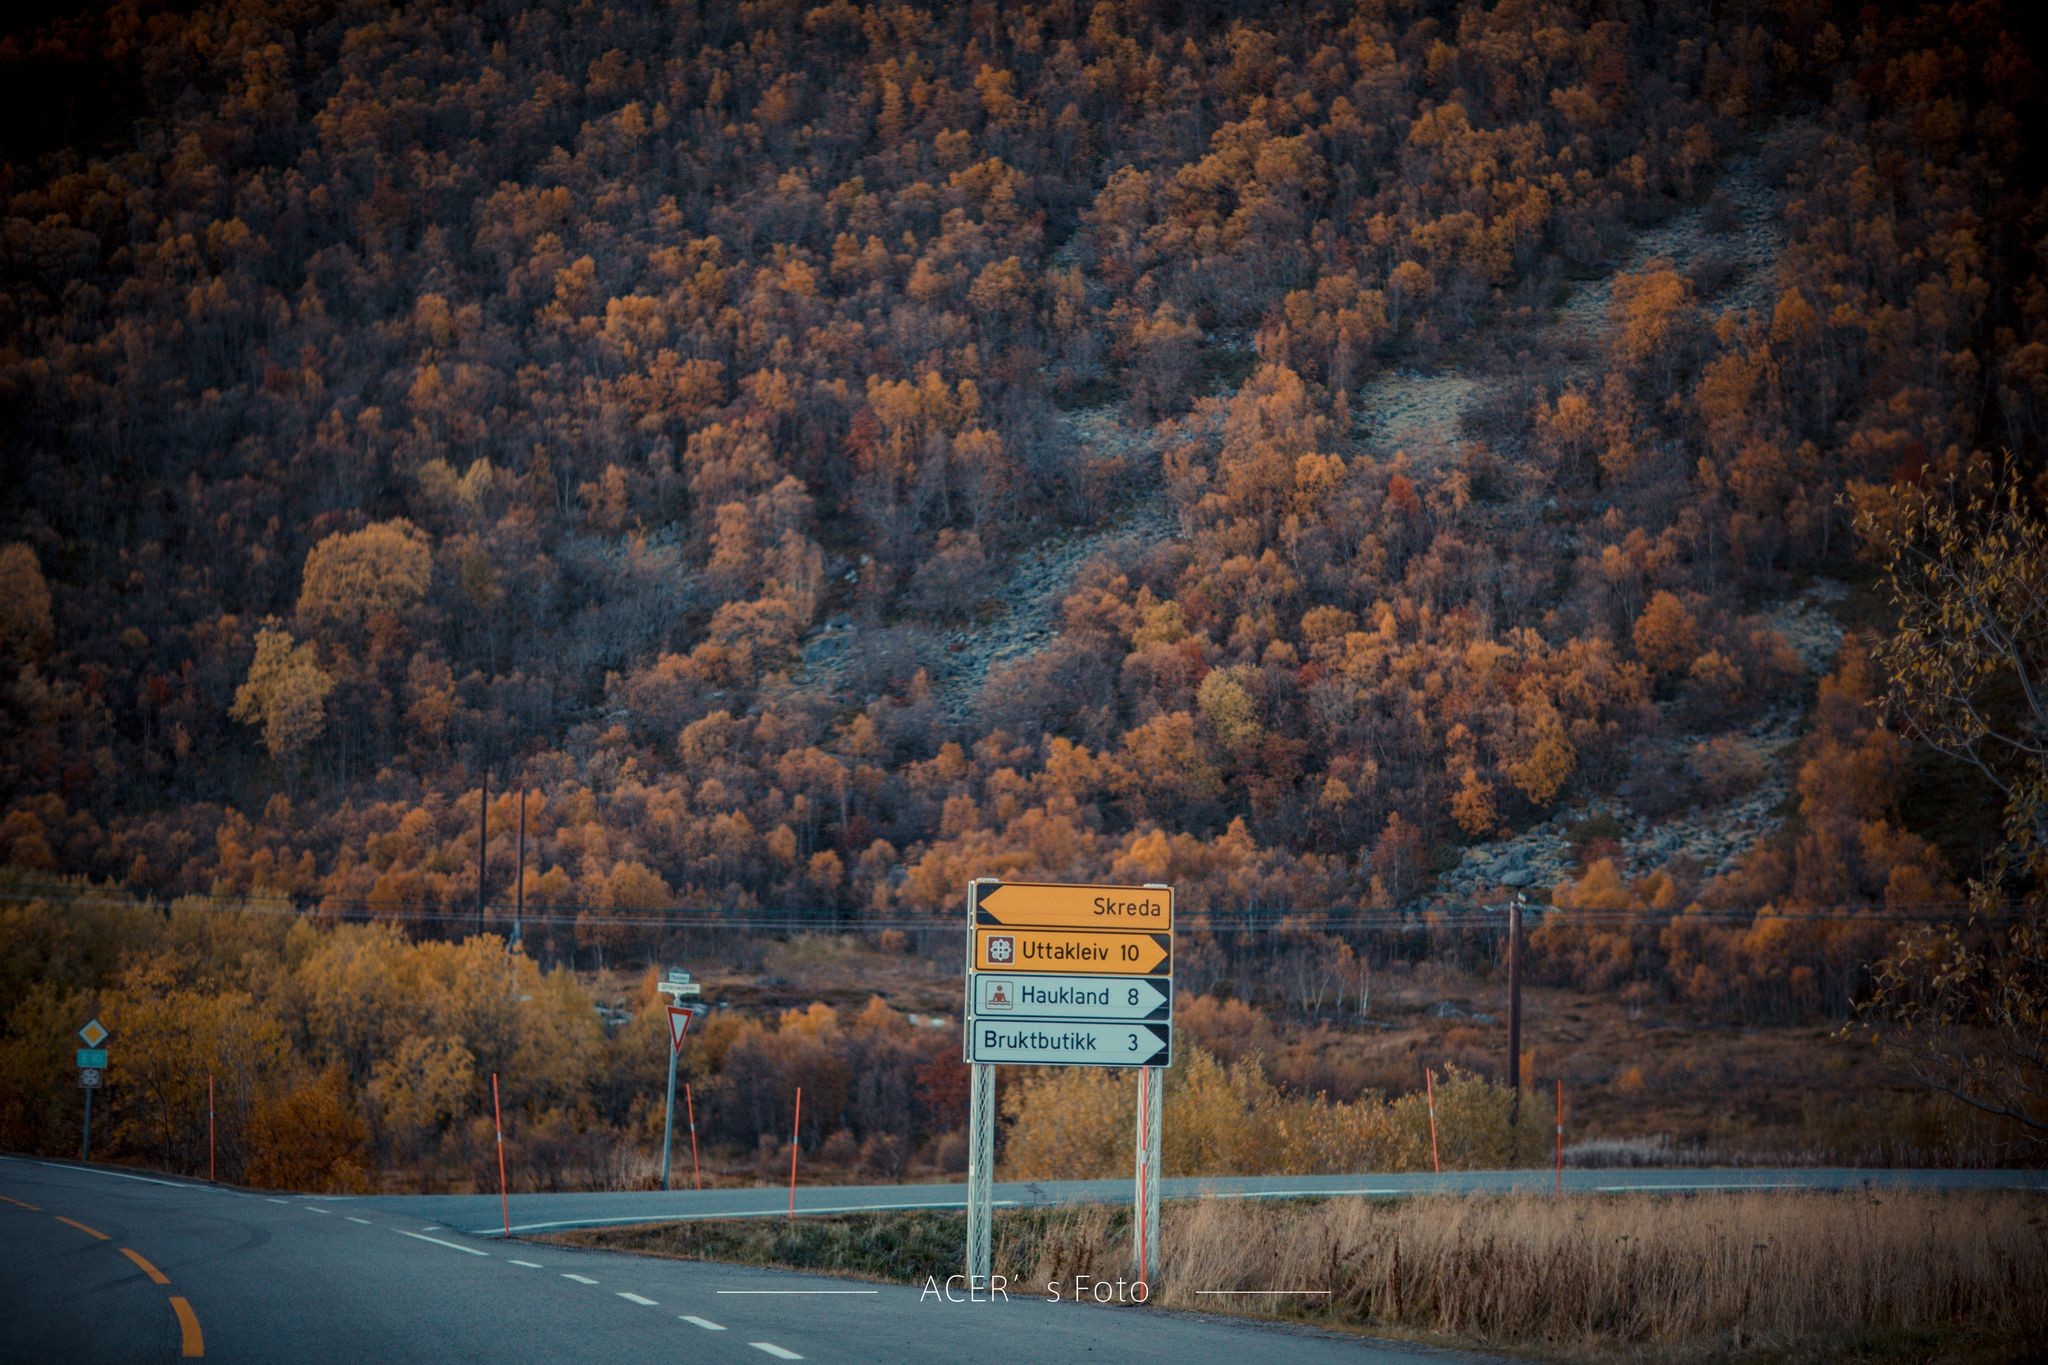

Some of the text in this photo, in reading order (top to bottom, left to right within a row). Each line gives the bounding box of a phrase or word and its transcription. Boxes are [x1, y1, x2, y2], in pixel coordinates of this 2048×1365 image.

[1093, 897, 1161, 917] Skreda
[1022, 941, 1139, 962] Uttakleiv 10
[1022, 985, 1139, 1006] Haukland 8
[985, 1030, 1138, 1051] Bruktbutikk 3
